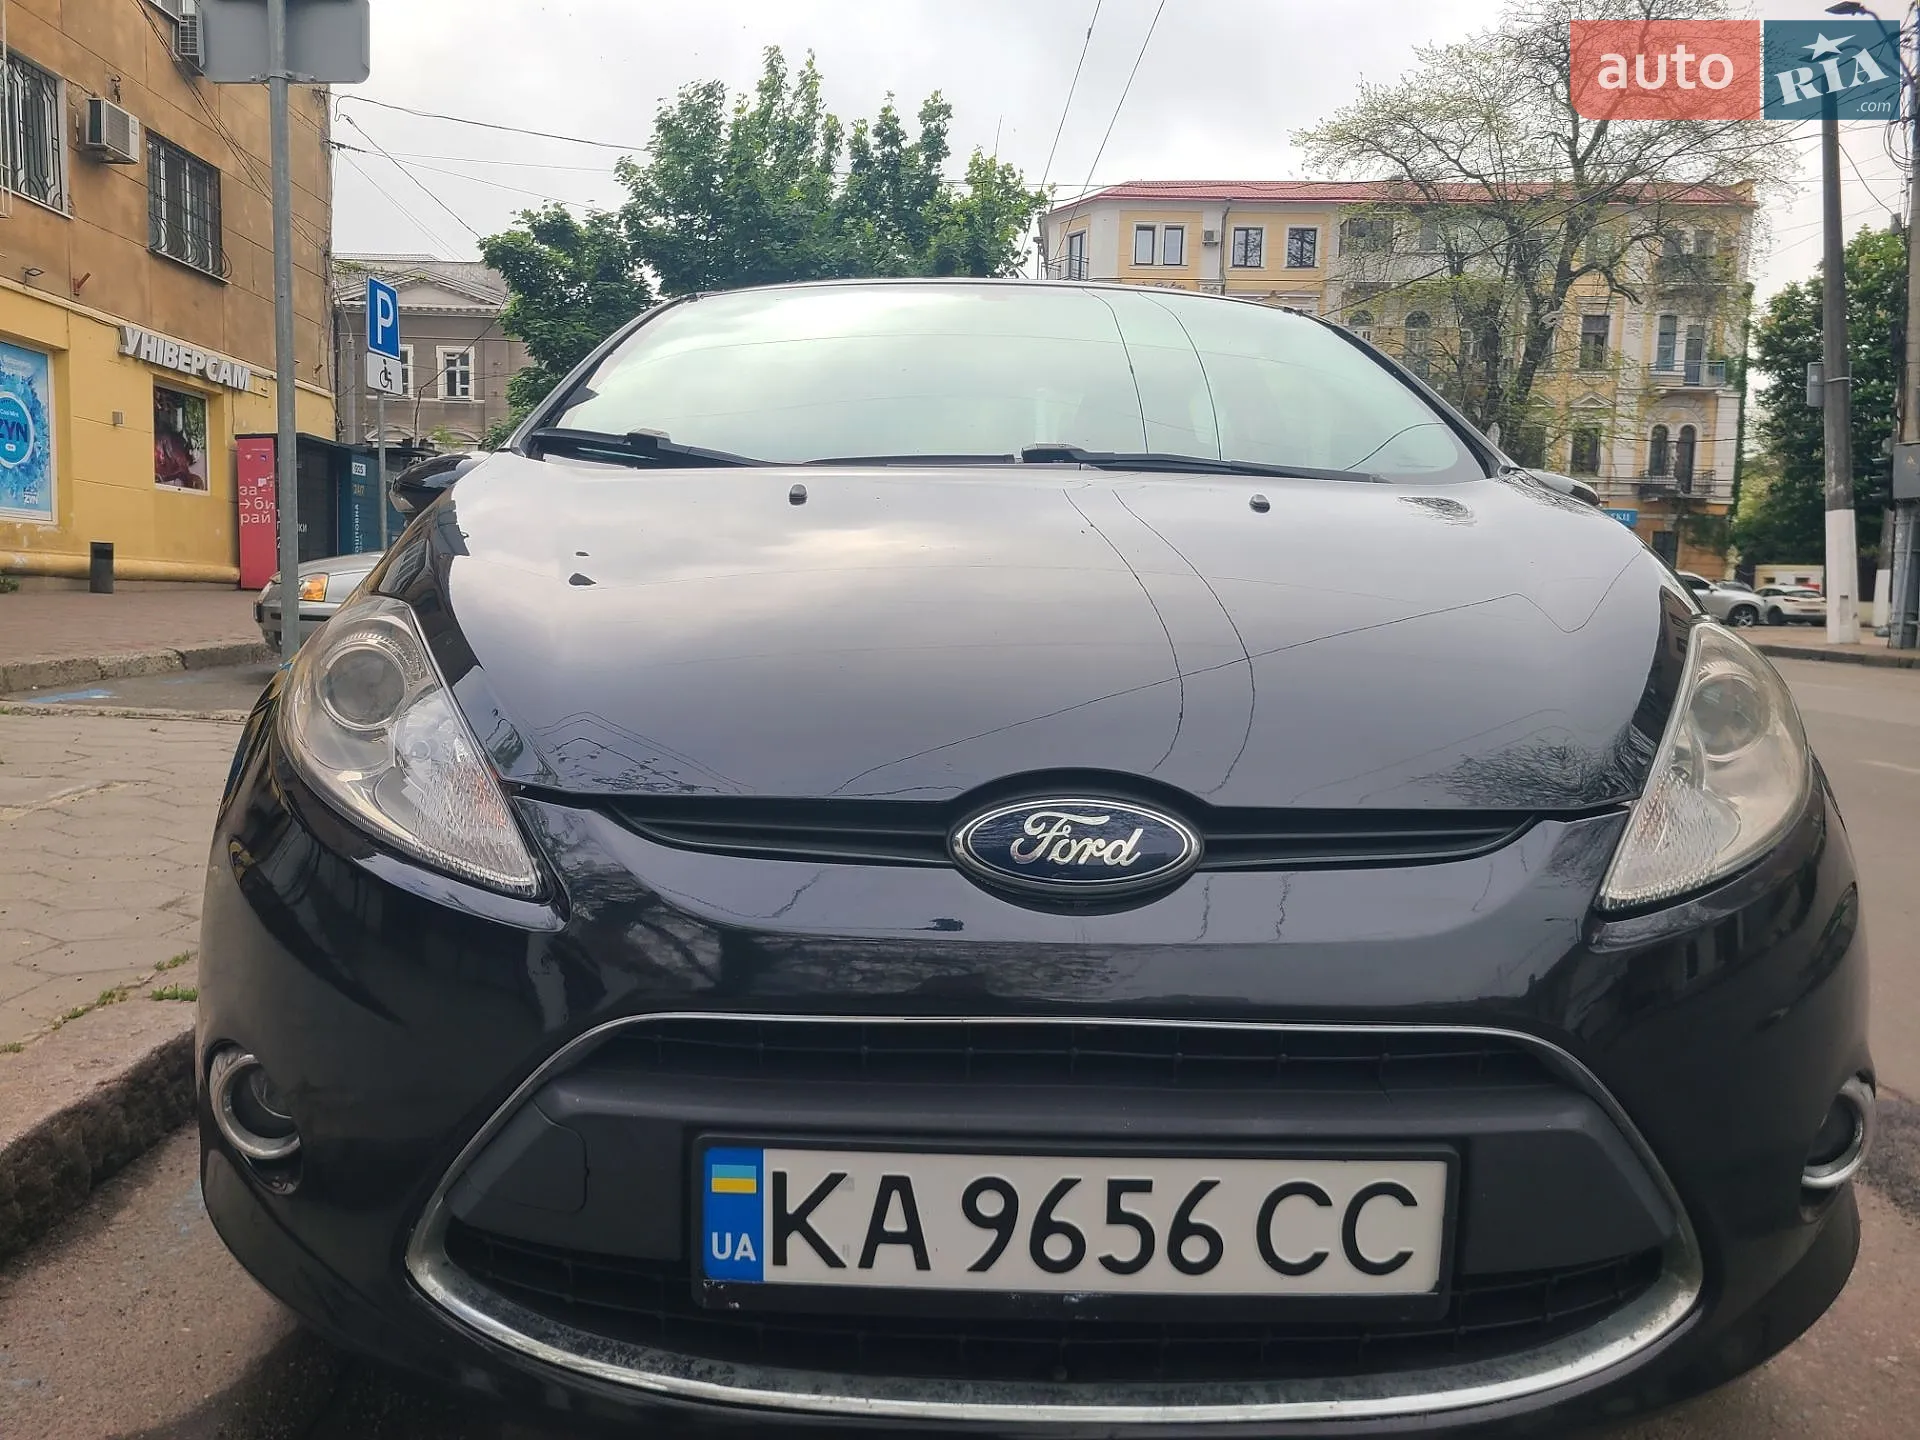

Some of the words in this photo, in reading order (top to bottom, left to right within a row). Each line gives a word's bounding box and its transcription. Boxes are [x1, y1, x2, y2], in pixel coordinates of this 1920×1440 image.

[376, 288, 394, 345] P
[123, 325, 250, 392] УНІВЕРСАМ
[240, 510, 272, 526] рай
[253, 497, 275, 510] би
[1009, 811, 1144, 867] Ford
[711, 1232, 756, 1262] UA
[771, 1171, 931, 1272] KA
[960, 1175, 1224, 1275] 9656
[1256, 1180, 1418, 1276] CC
